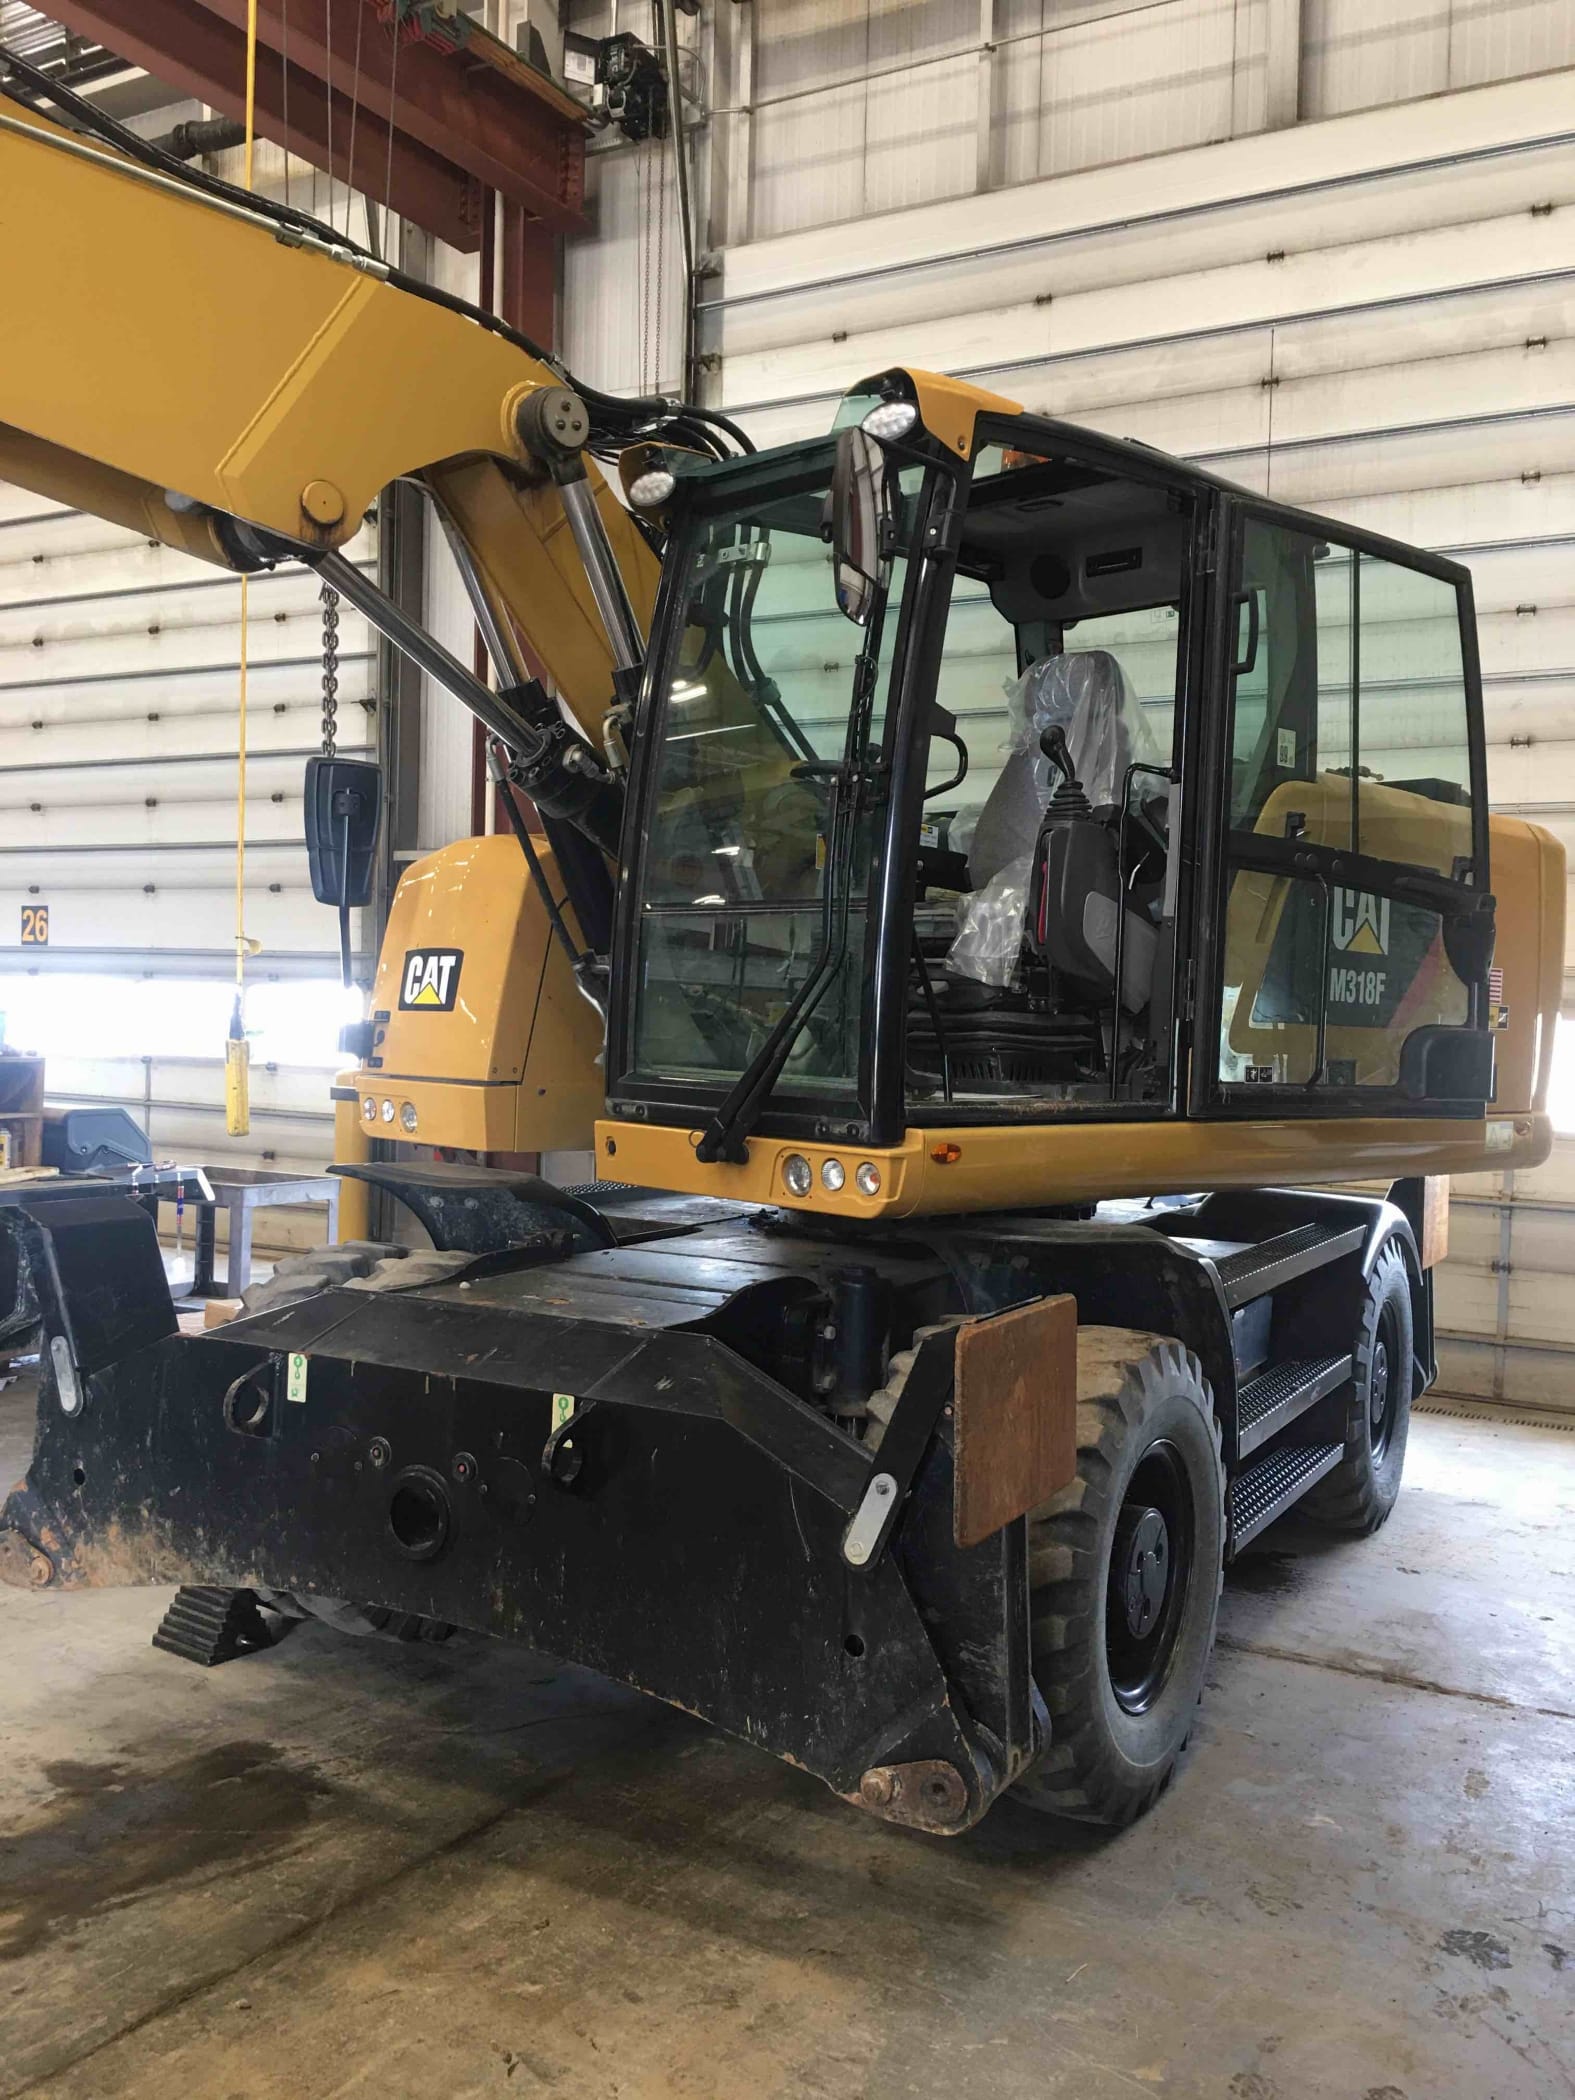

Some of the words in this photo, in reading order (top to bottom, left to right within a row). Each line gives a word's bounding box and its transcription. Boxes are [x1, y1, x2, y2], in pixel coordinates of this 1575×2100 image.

[22, 909, 48, 942] 26
[404, 955, 456, 1004] CAT
[1329, 967, 1386, 1005] M318F
